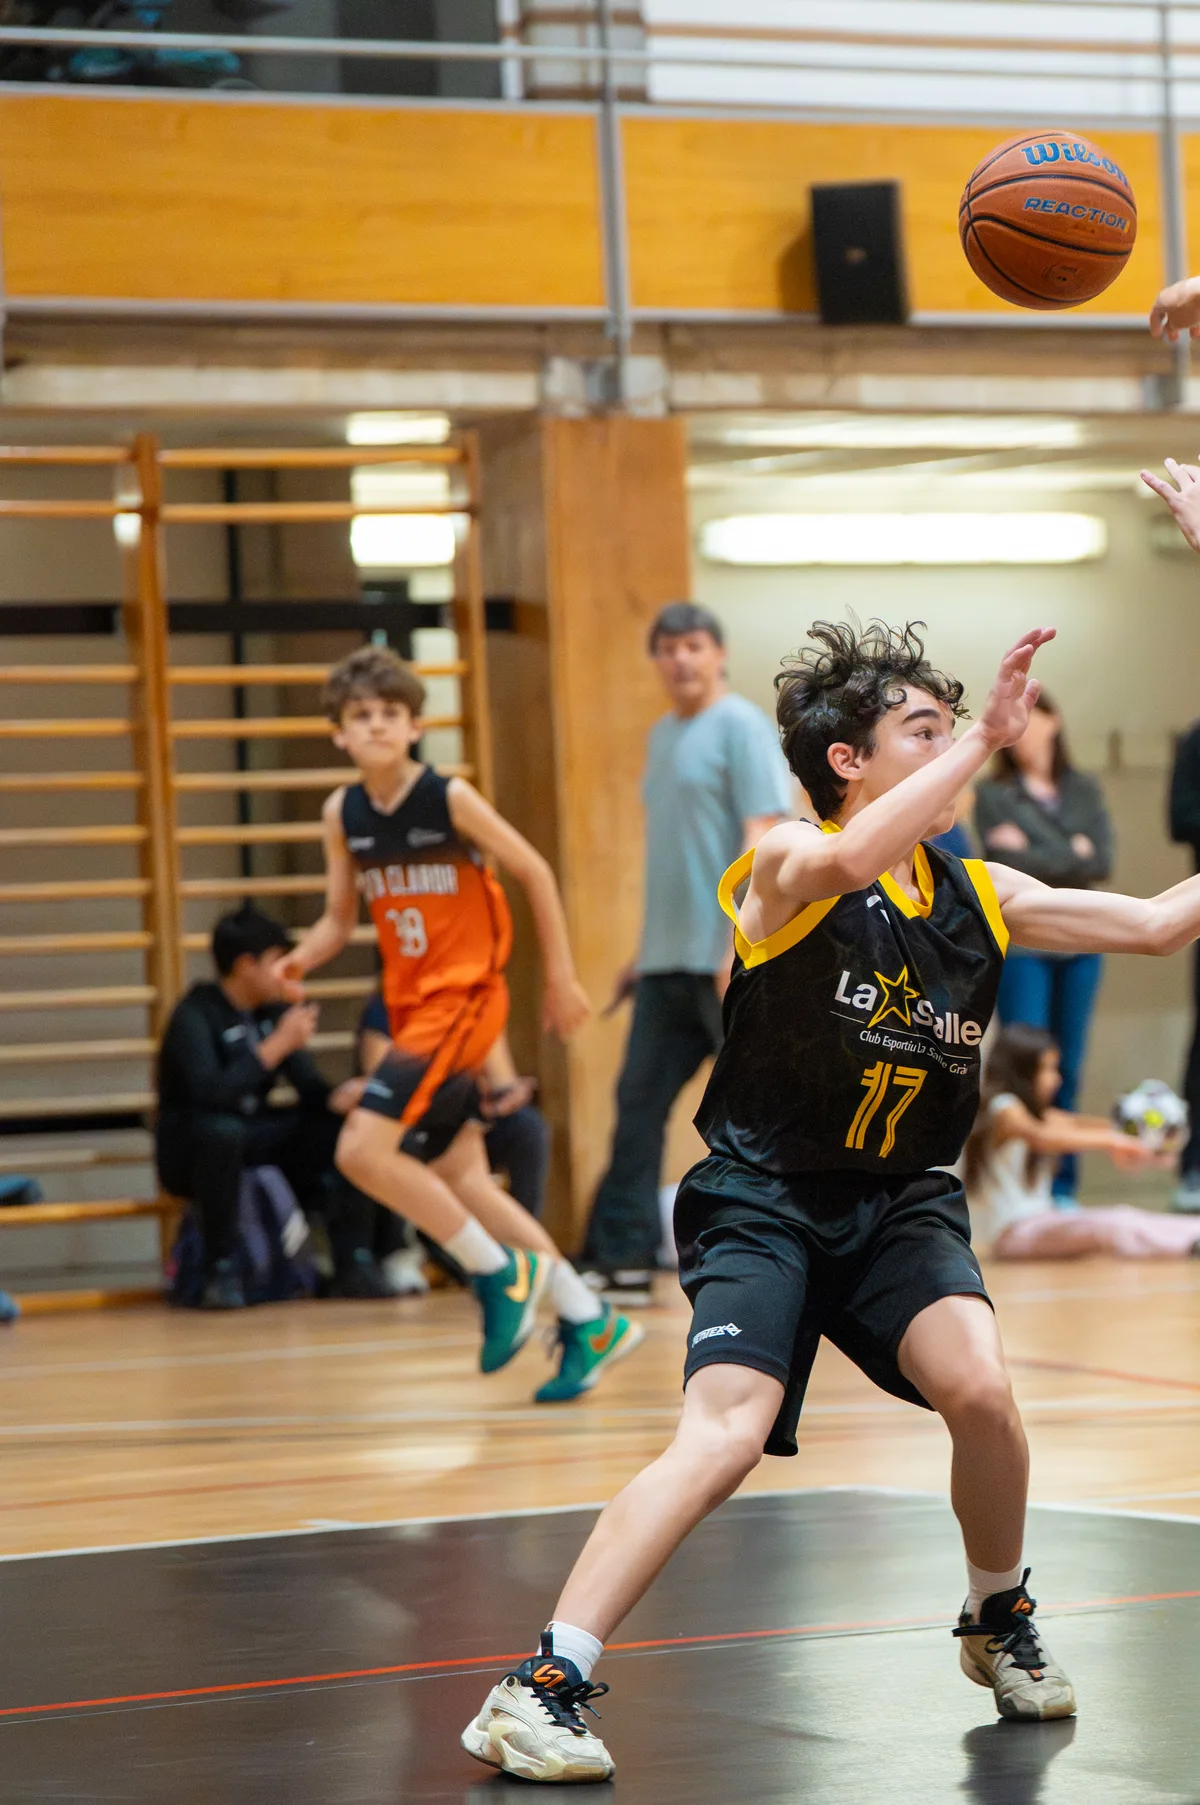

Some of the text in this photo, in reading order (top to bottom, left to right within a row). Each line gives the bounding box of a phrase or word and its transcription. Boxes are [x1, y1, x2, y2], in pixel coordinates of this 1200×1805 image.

[1020, 142, 1129, 187] Wilson
[1023, 197, 1128, 231] REACTION
[834, 970, 982, 1046] La Salle
[860, 1030, 881, 1045] Club
[882, 1035, 917, 1052] Esportiu
[917, 1042, 926, 1054] La
[927, 1047, 947, 1068] Salle
[845, 1061, 928, 1158] 17
